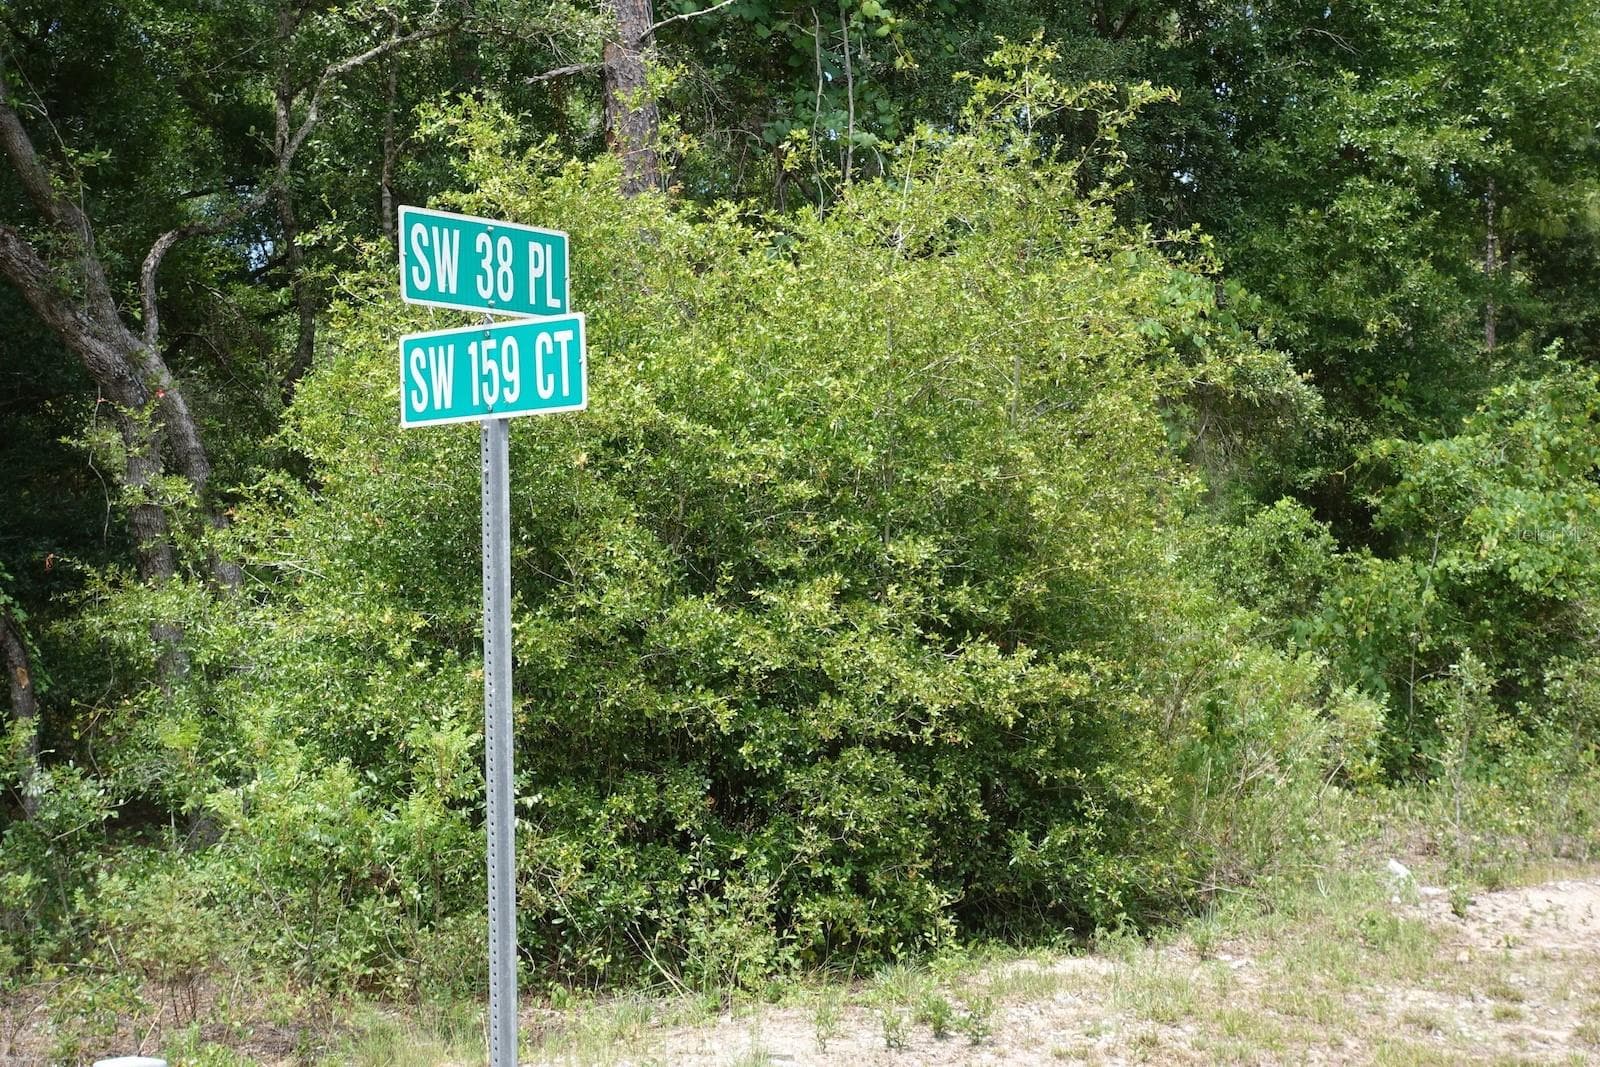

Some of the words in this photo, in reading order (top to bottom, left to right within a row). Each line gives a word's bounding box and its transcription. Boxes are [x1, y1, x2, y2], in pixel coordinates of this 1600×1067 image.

[410, 222, 460, 294] SW
[475, 232, 515, 302] 38
[528, 241, 561, 308] PL
[409, 344, 455, 413] SW
[467, 335, 521, 406] 159
[535, 329, 574, 400] CT
